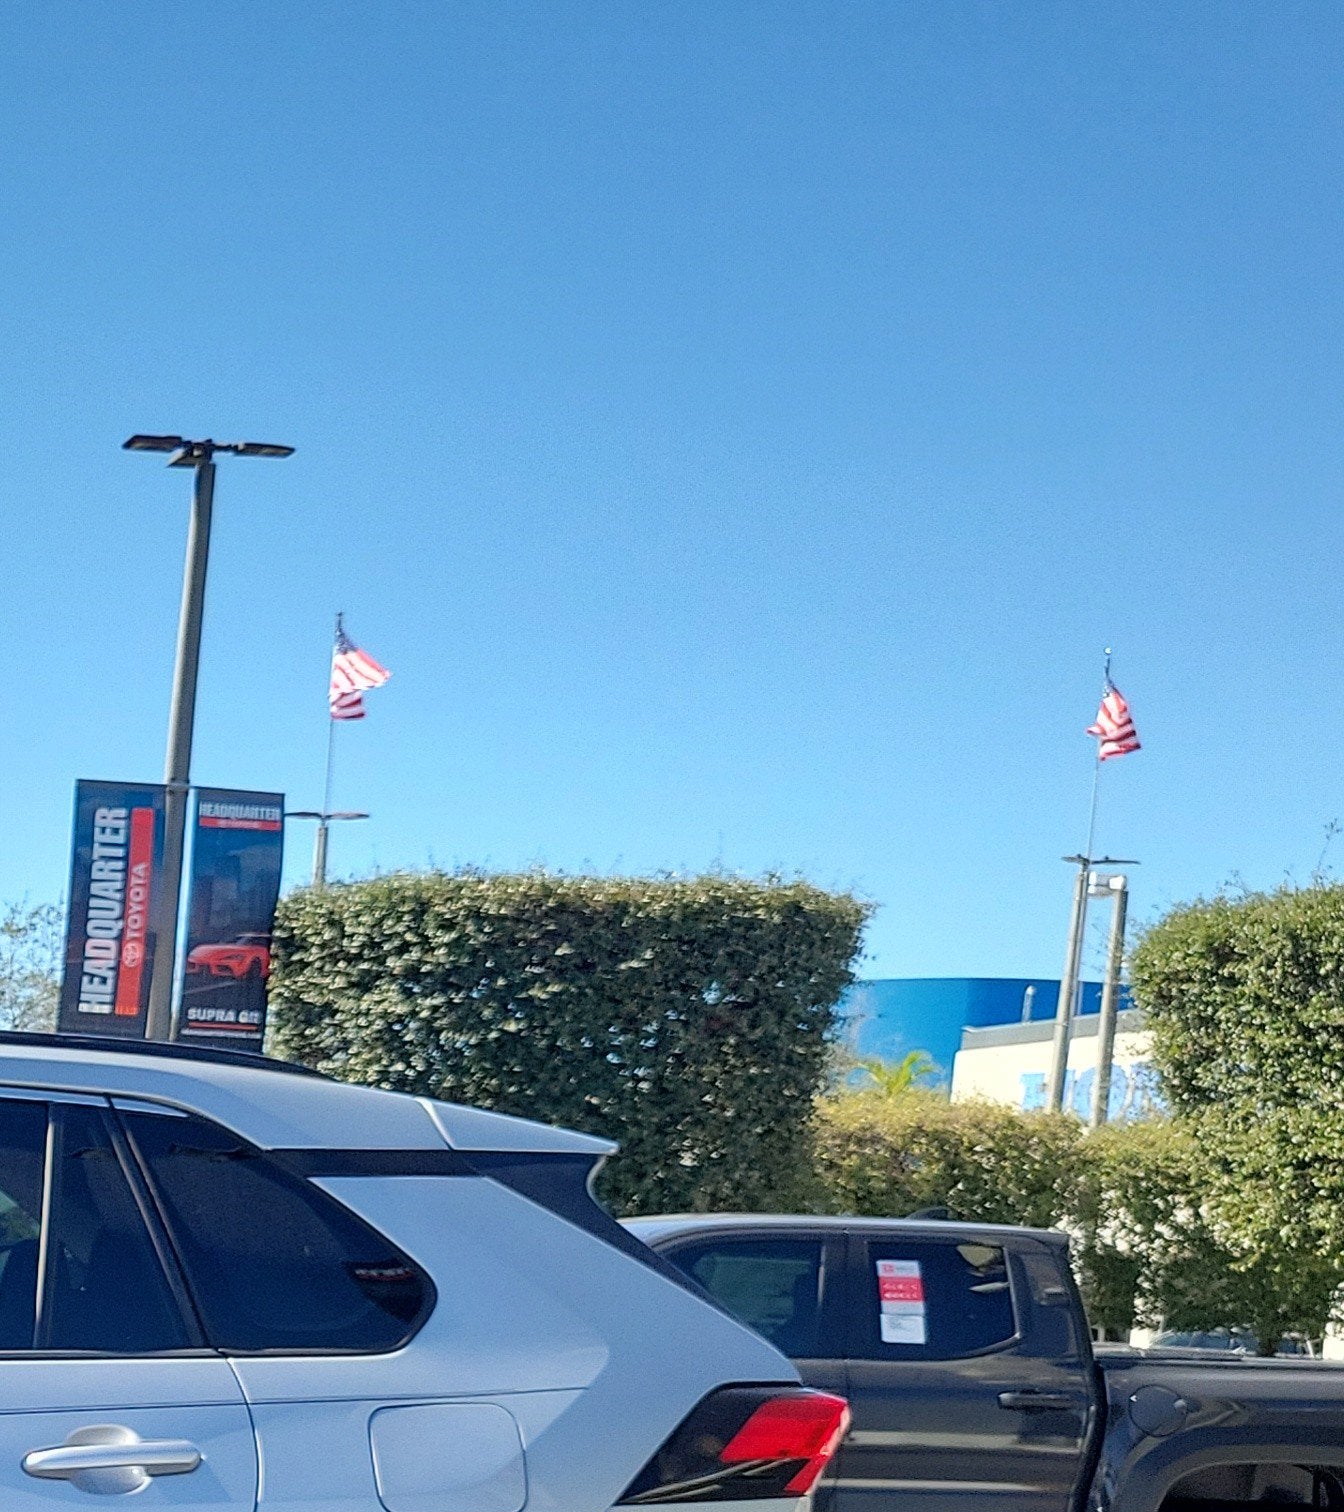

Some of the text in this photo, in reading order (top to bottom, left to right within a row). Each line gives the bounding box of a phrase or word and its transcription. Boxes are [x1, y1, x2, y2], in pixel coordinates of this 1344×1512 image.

[78, 807, 128, 1015] HEADQUARTER
[126, 863, 148, 938] TOYOTA
[187, 1007, 236, 1022] SUPRA
